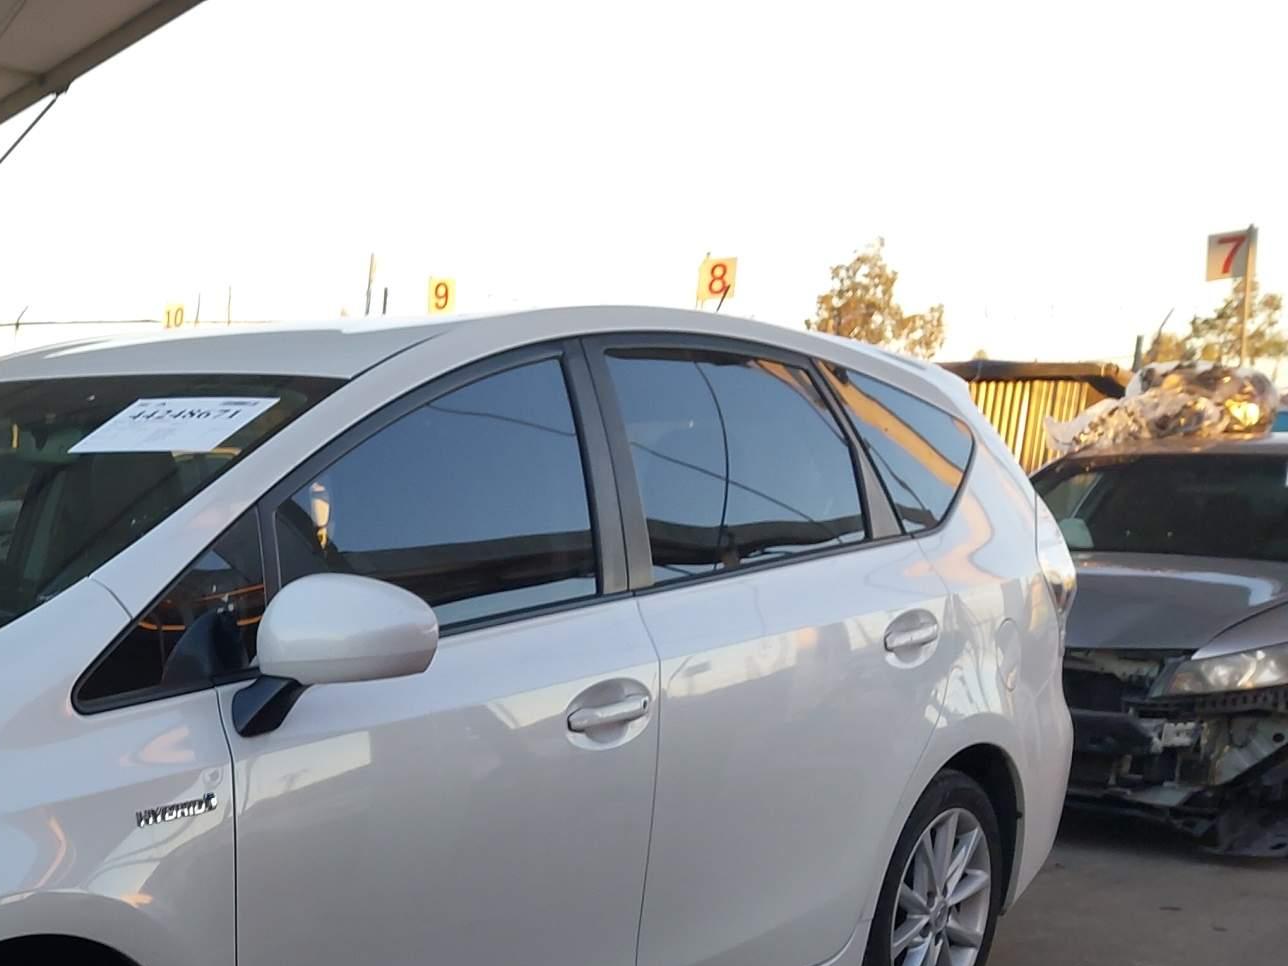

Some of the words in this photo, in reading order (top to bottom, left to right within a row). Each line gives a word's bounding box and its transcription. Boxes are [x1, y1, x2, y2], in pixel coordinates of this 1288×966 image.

[1217, 234, 1246, 274] 7
[708, 263, 727, 294] 8
[435, 282, 448, 310] 9
[165, 307, 184, 328] 10
[129, 408, 242, 420] 44248671
[135, 799, 206, 828] HYBRID
